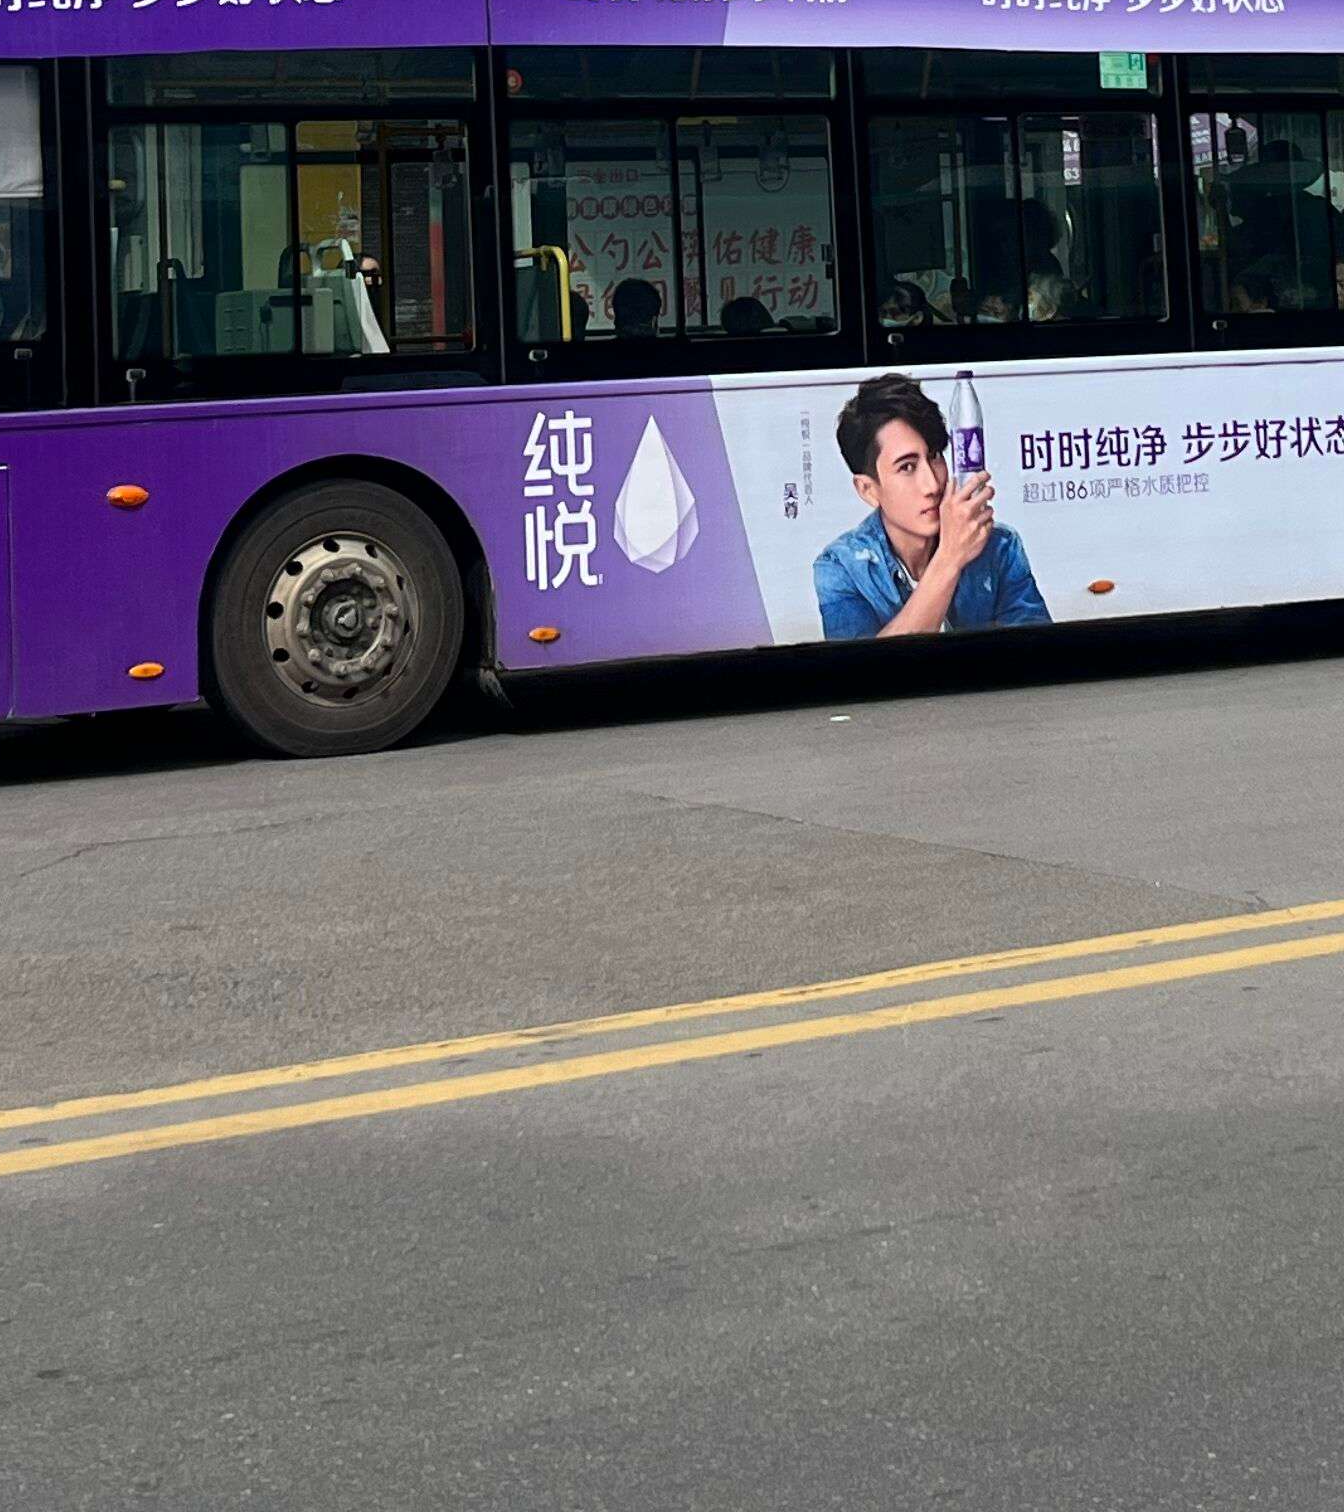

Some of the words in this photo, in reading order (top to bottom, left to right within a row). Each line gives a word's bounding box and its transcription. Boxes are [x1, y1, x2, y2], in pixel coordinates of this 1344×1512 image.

[1020, 423, 1168, 473] 时时纯净
[522, 410, 604, 590] 纯悦
[1022, 472, 1210, 504] 超过186项严格水质把控
